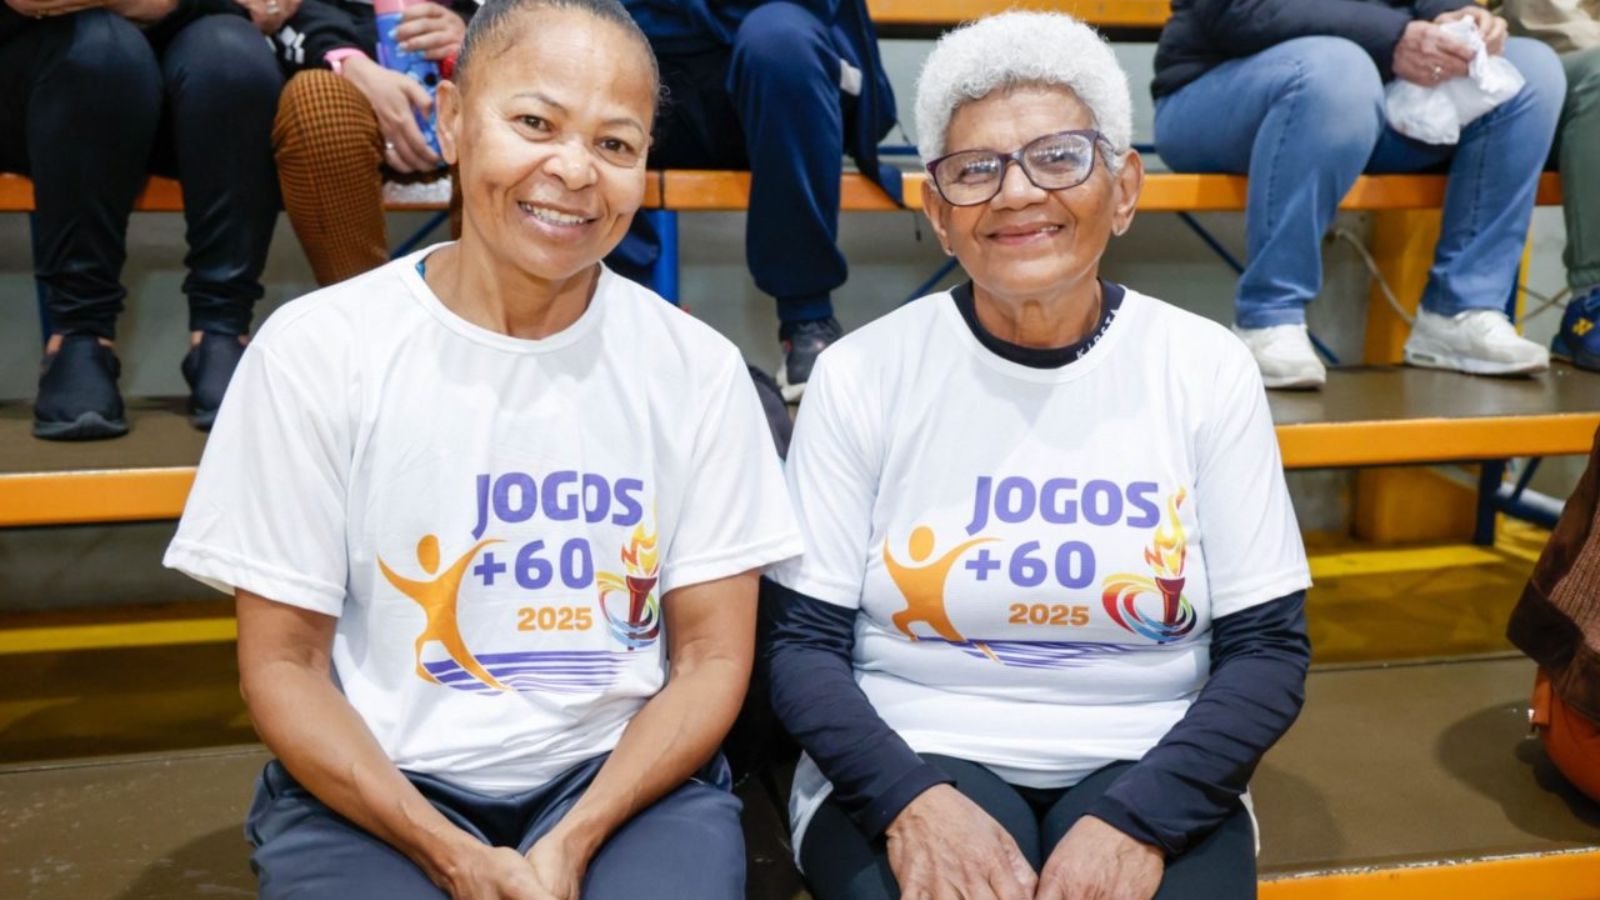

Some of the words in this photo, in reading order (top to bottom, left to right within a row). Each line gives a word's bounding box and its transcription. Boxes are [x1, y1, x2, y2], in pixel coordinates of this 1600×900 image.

[471, 470, 644, 540] JOGOS
[965, 476, 1161, 536] JOGOS
[473, 538, 595, 590] +60
[965, 540, 1096, 589] +60
[517, 606, 593, 631] 2025
[1008, 603, 1090, 626] 2025
